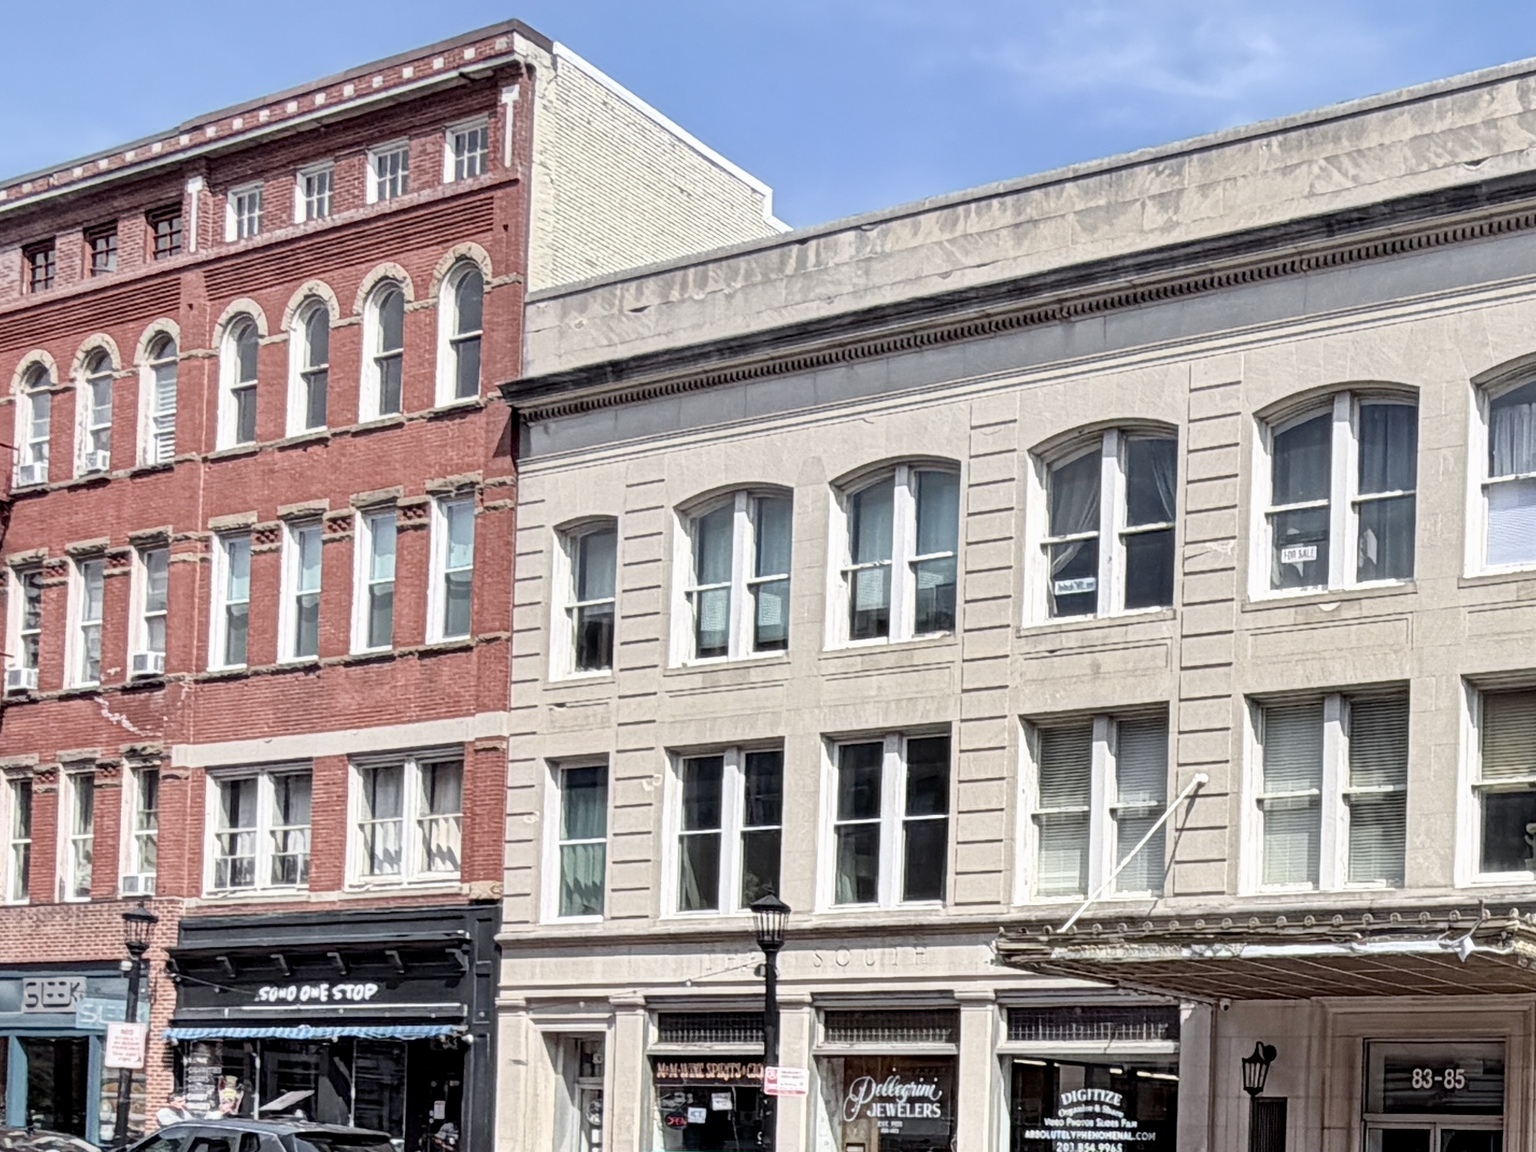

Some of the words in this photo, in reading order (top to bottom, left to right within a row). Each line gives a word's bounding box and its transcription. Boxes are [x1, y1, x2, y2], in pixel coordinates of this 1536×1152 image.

[300, 983, 329, 1002] ONE
[332, 983, 378, 1001] STOP
[1412, 1068, 1465, 1089] 83-85
[843, 1075, 943, 1122] Pellegrini
[1061, 1088, 1123, 1107] DIGITIZE
[866, 1103, 942, 1118] JEWELERS
[1024, 1130, 1156, 1141] ABSOLUTELYPHENOMENAL.COM
